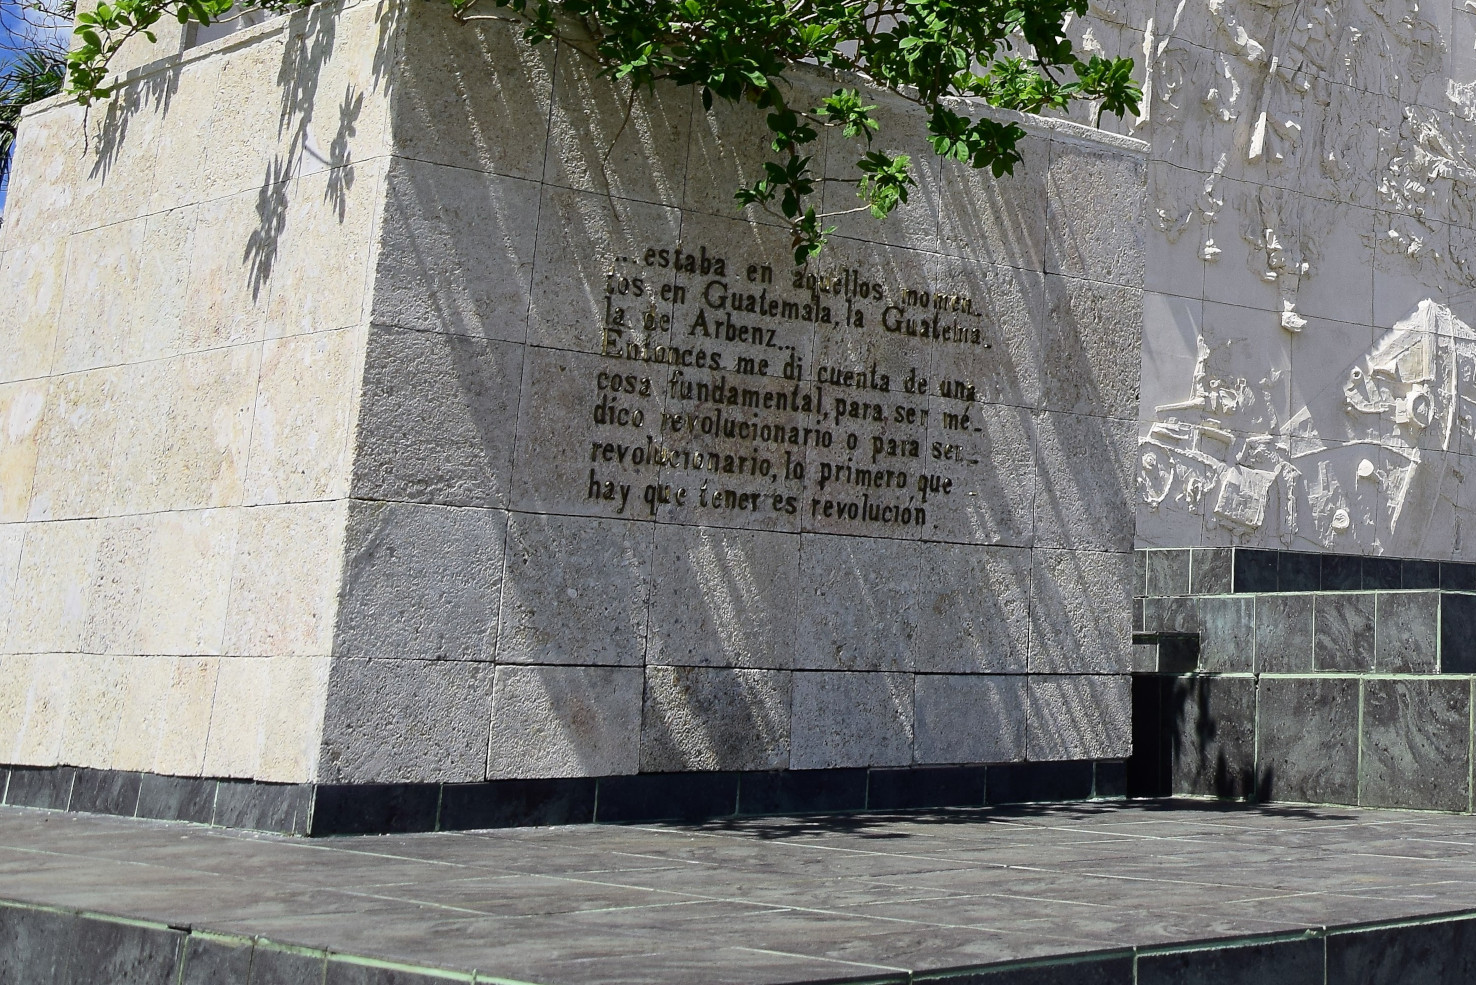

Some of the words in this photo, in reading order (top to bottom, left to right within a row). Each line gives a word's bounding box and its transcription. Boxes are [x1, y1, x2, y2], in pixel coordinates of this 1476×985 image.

[605, 266, 645, 297] tos
[660, 283, 686, 305] en
[702, 280, 840, 331] Guatemala,
[846, 297, 865, 328] la
[746, 263, 773, 284] en
[792, 268, 884, 302] aquellos
[605, 296, 626, 327] la
[643, 303, 671, 332] de
[687, 308, 796, 351] Arbenz...
[600, 327, 723, 371] Entonces
[736, 355, 769, 376] me
[783, 352, 803, 382] di
[817, 363, 890, 392] cuenta
[903, 367, 928, 395] de
[939, 379, 976, 402] una
[597, 372, 651, 397] cosa
[669, 370, 829, 421] fundamental,
[834, 397, 884, 426] para
[894, 405, 930, 426] ser
[943, 406, 983, 432] mé-
[661, 409, 833, 448] revolucionario
[847, 432, 858, 450] o
[872, 436, 920, 464] para
[587, 468, 631, 514] hay
[643, 482, 687, 515] que
[699, 478, 761, 512] tener
[771, 494, 798, 515] es
[590, 435, 778, 484] revolucionario,
[784, 451, 804, 480] lo
[820, 457, 908, 490] primero
[917, 473, 953, 504] que
